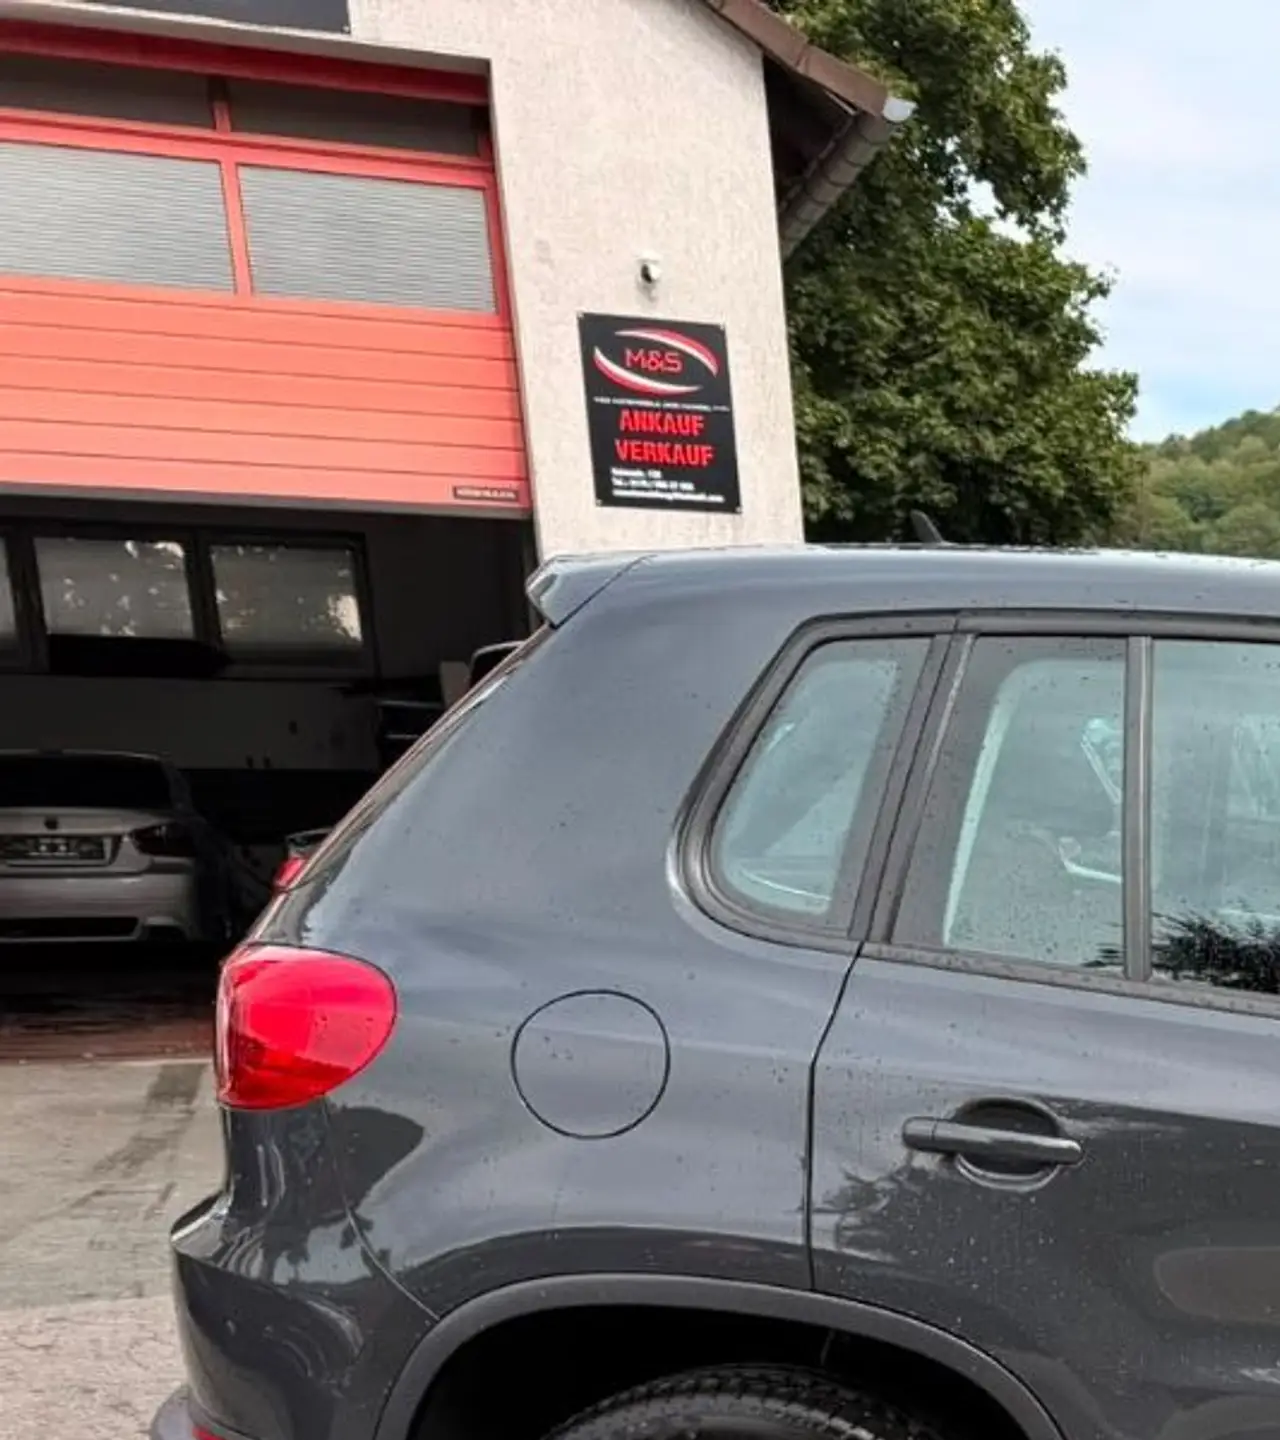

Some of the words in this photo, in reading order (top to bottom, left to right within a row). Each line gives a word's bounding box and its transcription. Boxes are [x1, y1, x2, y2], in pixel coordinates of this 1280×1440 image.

[625, 349, 683, 373] M&S
[619, 408, 706, 437] ANKAUF
[613, 438, 715, 468] VERKAUF
